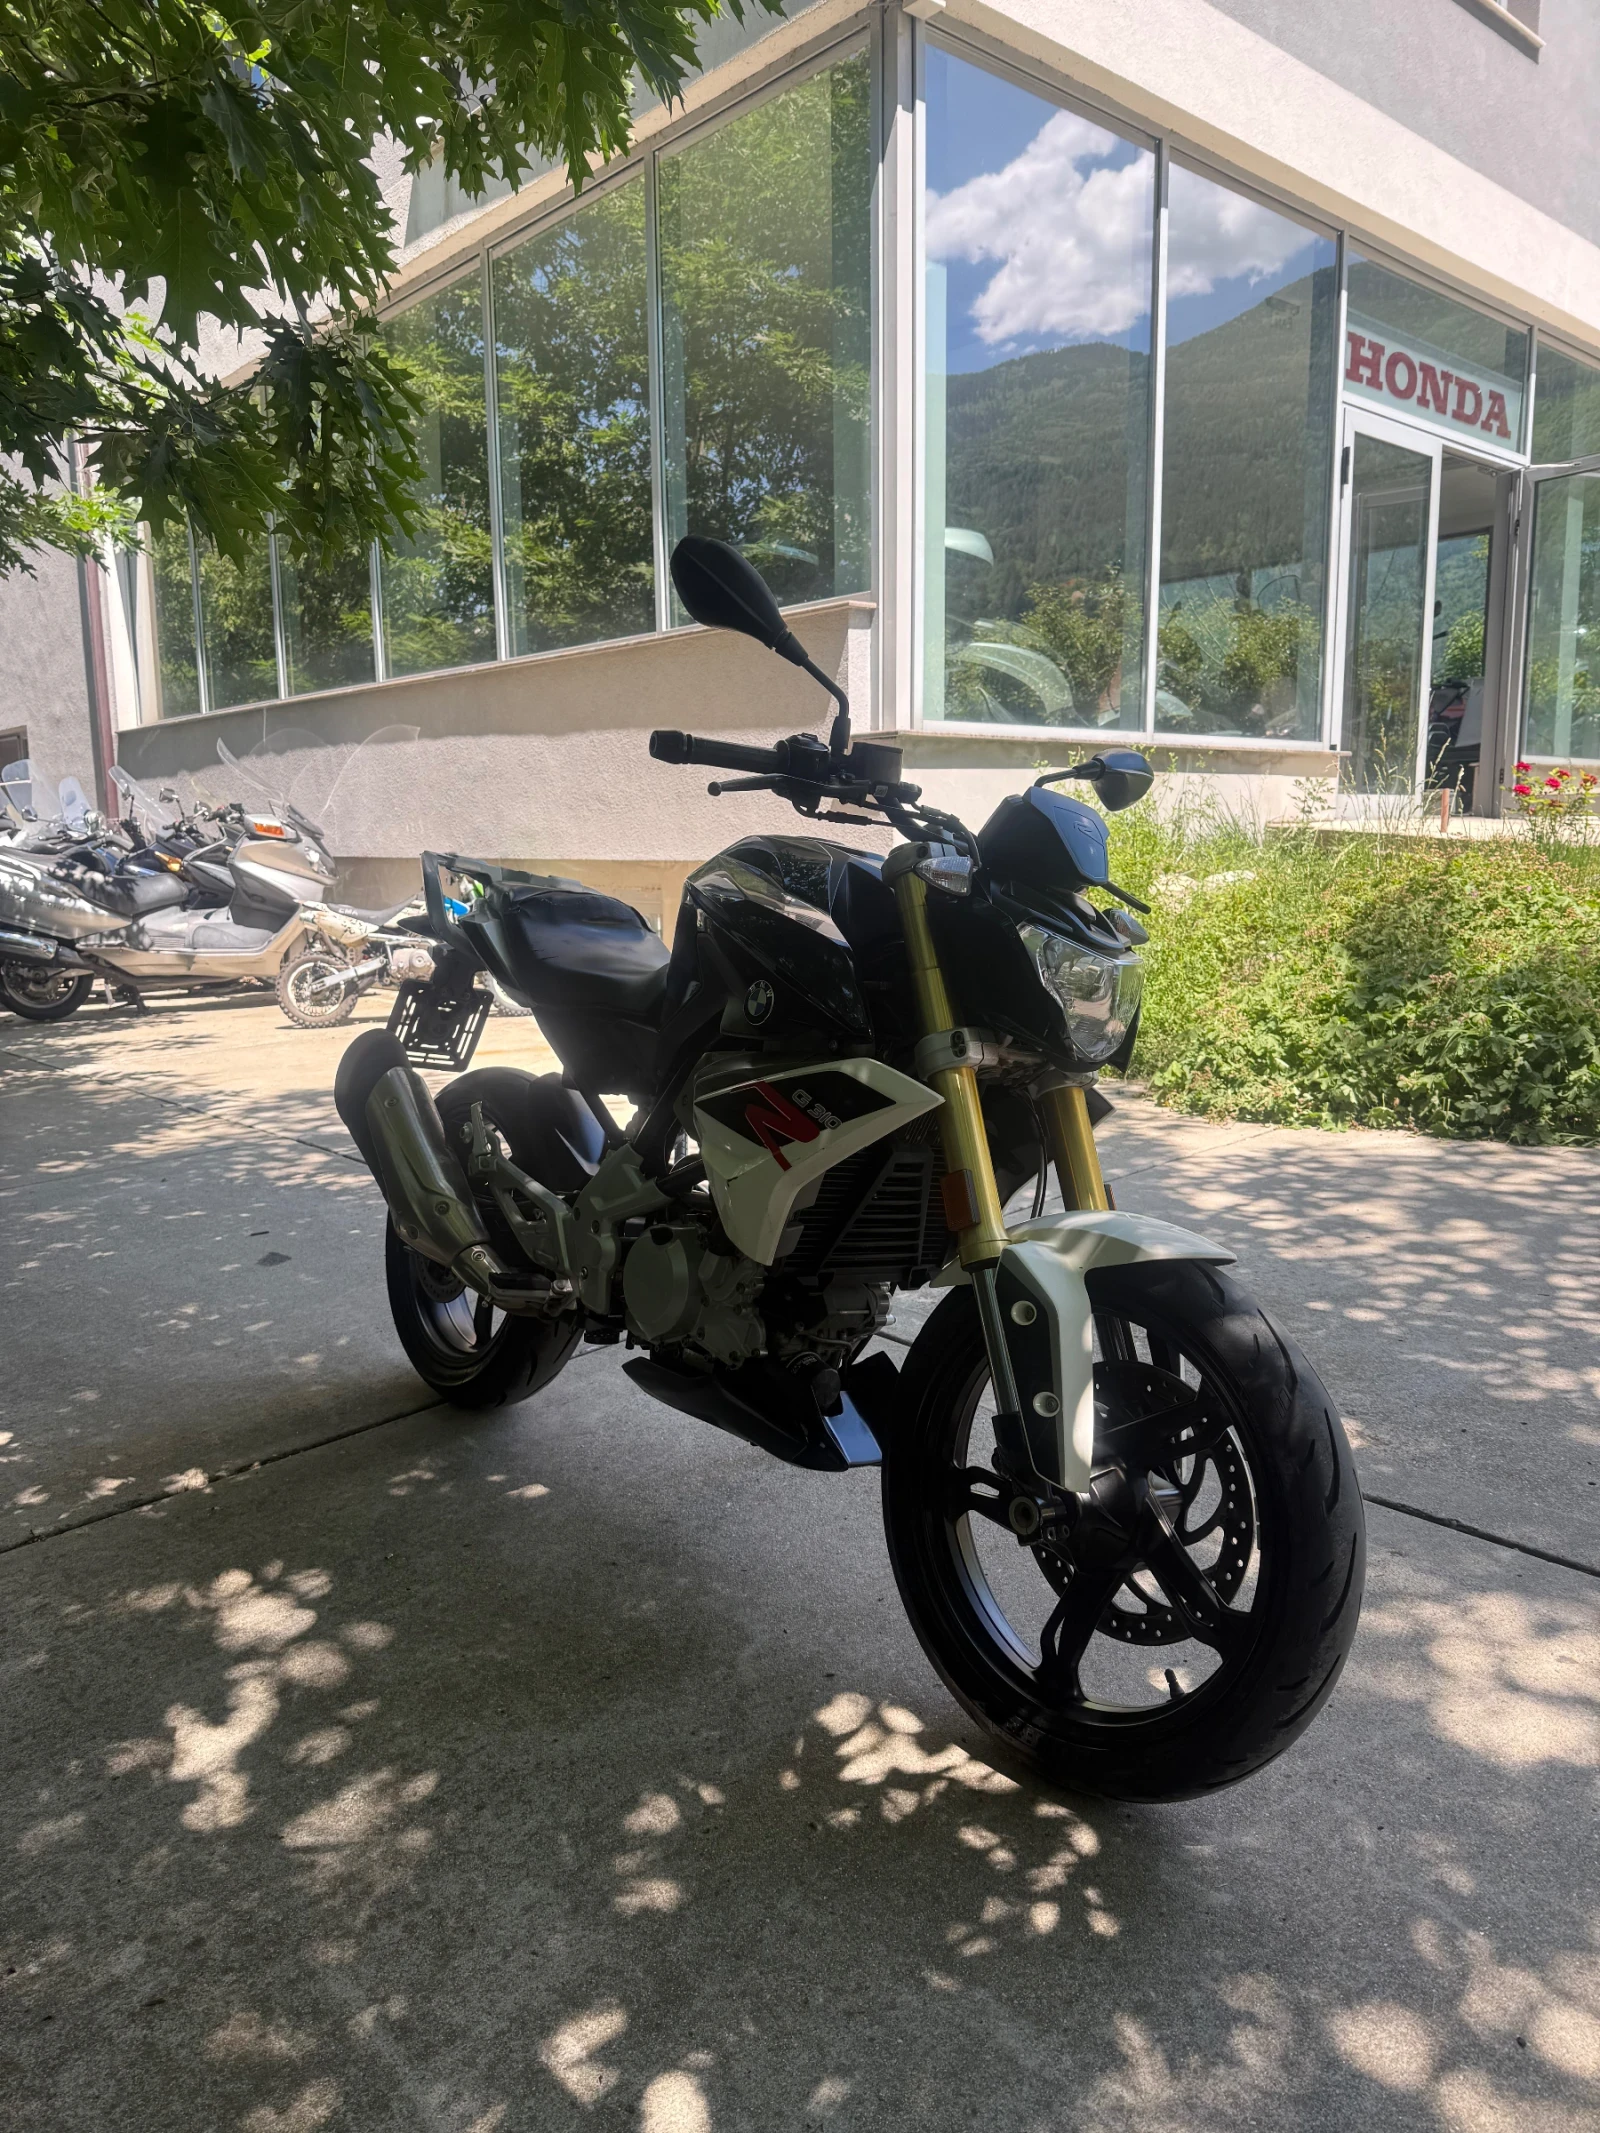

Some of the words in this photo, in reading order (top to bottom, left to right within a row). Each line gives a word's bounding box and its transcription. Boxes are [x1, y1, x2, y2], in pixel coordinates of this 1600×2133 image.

[1346, 332, 1511, 439] HONDA
[749, 981, 773, 998] BMW
[792, 1089, 812, 1108] G
[807, 1103, 842, 1130] 310
